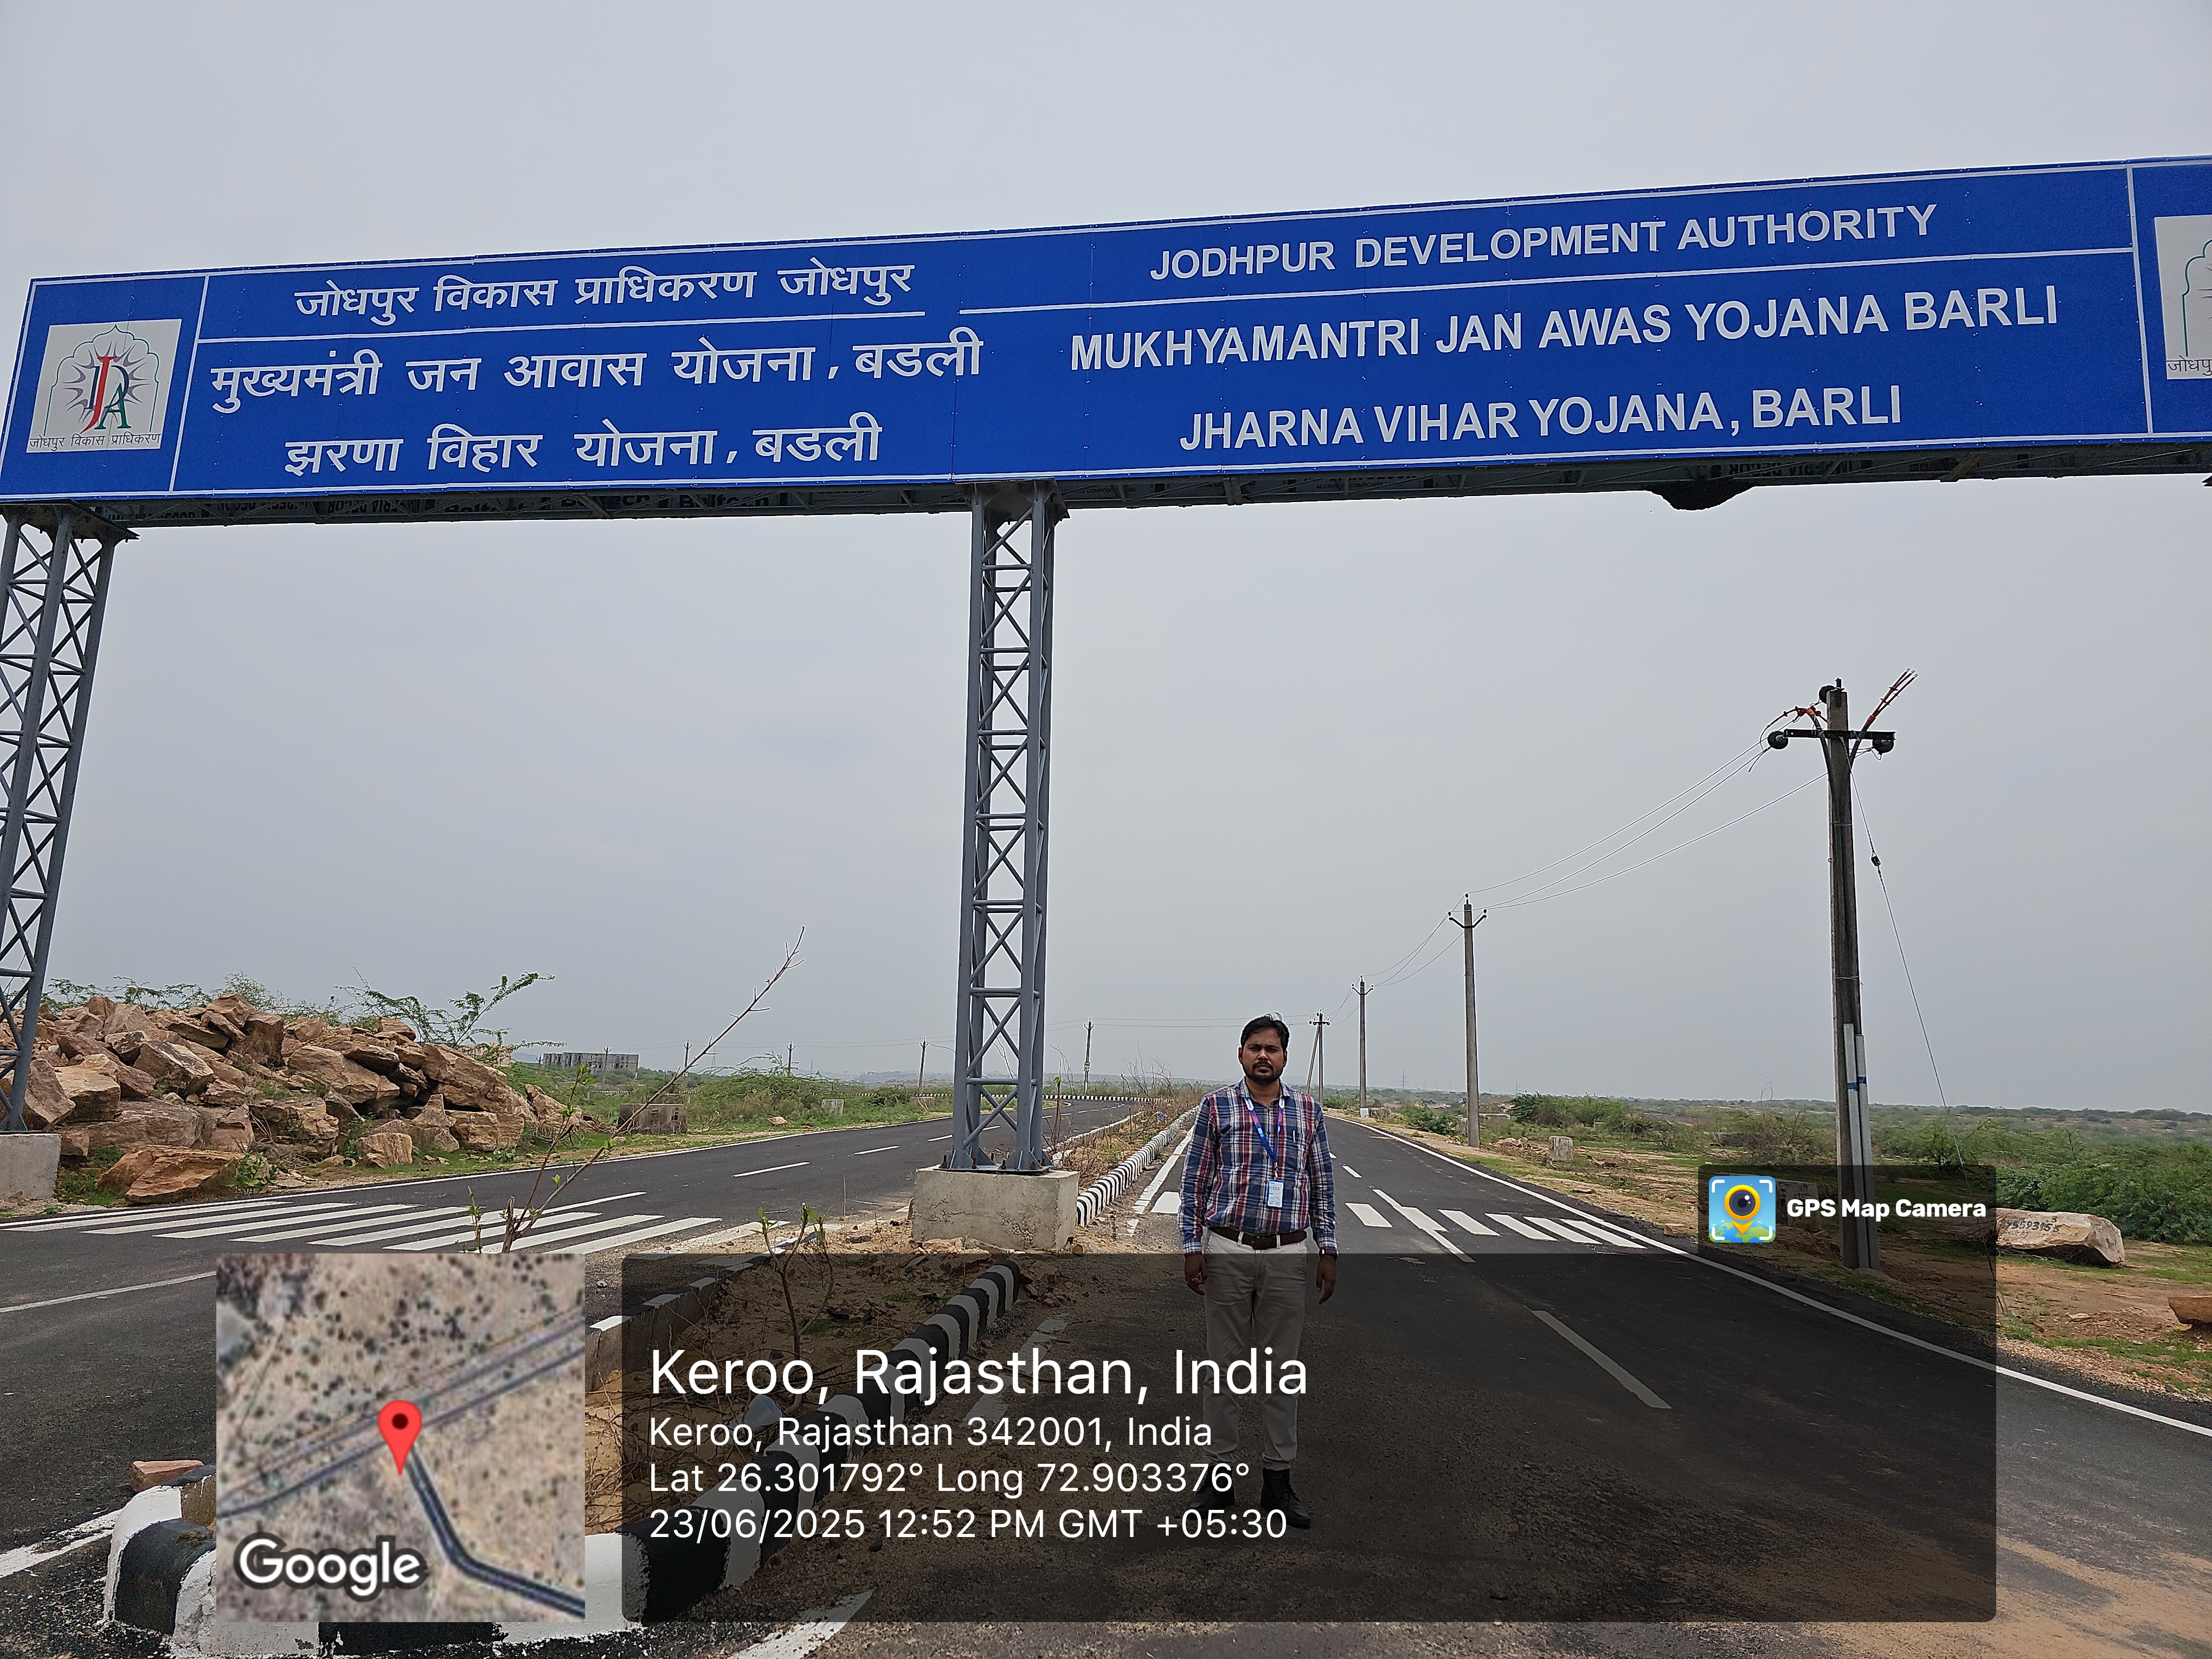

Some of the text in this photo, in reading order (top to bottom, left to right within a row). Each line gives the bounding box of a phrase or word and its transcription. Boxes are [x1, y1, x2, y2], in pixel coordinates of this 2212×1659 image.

[1150, 204, 1937, 280] JODHPUR DEVELOPMENT AUTHORITY
[294, 257, 915, 325] जोधपुर विकास प्राधिकरण जोधपुर
[1072, 286, 2056, 370] MUKHYAMANTRI JAN AWAS YOJANA BARLI
[210, 349, 383, 413] मुख्यमंत्री
[406, 358, 481, 391] जन
[504, 353, 647, 388] आवास
[852, 327, 983, 378] बडली
[2166, 354, 2212, 376] जोधपु
[29, 431, 162, 451] जोधपुर विकास प्राधिकरण
[285, 439, 403, 476] झरणा
[427, 423, 543, 472] विहार
[753, 412, 882, 462] बडली
[1180, 385, 1900, 450] JHARNA VIHAR YOJANA, BARLI
